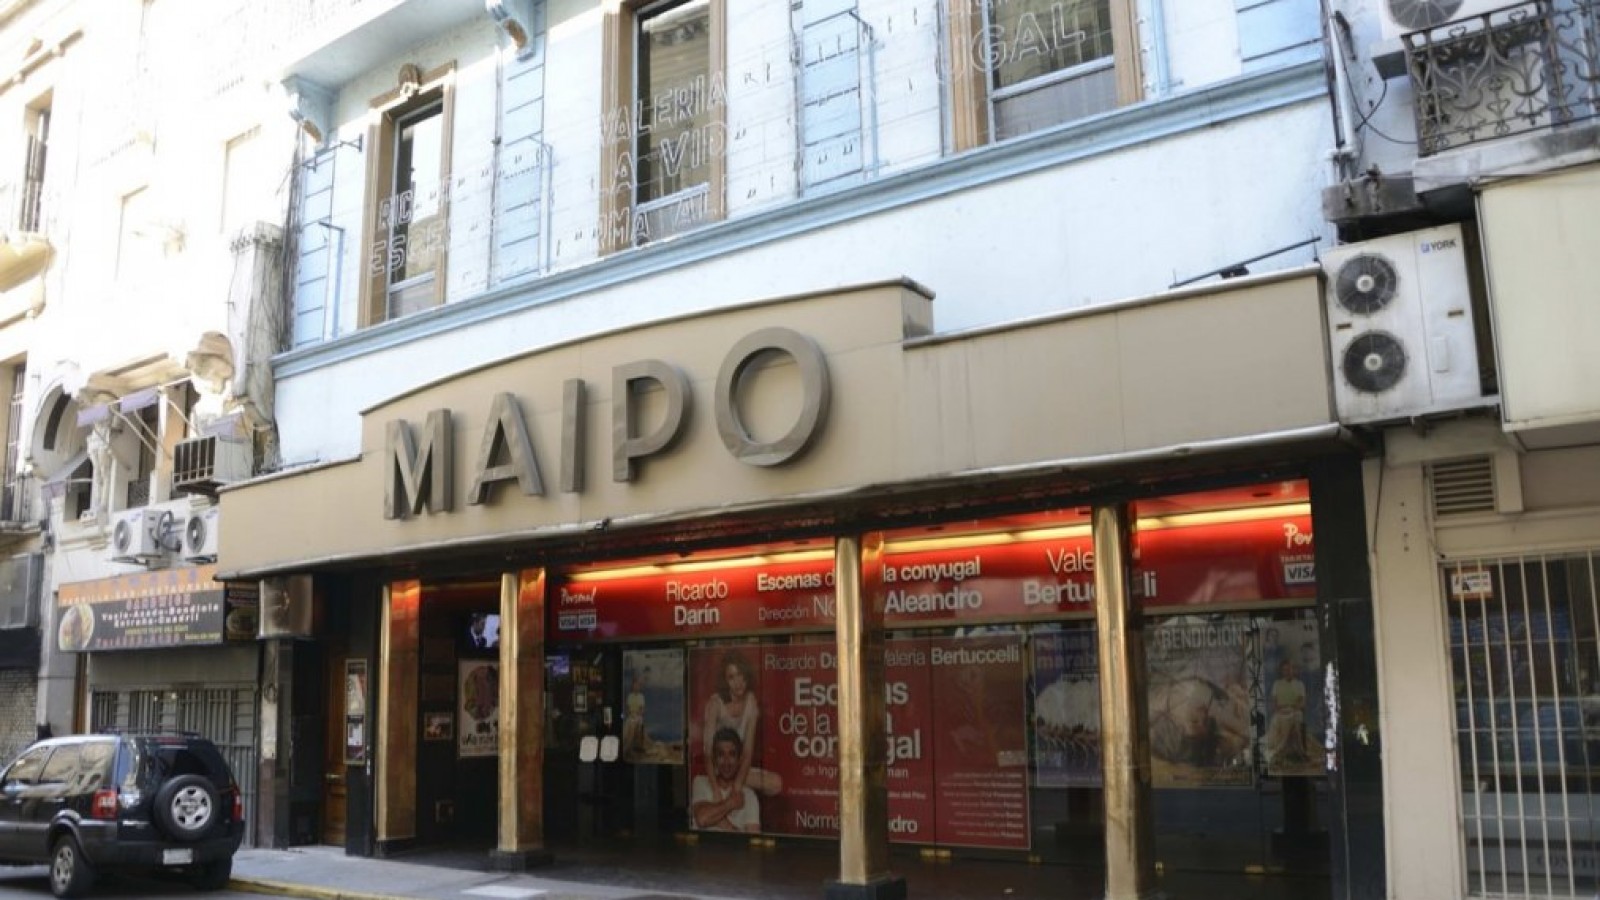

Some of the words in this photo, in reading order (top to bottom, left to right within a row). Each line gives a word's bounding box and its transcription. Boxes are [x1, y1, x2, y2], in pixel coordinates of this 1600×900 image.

[384, 327, 830, 520] MAIPO
[758, 573, 821, 592] Escenas
[900, 555, 980, 582] conyugal
[666, 580, 728, 602] Ricardo
[885, 587, 982, 614] Aleandro
[1023, 571, 1157, 605] Bertuli
[674, 603, 720, 626] Darín
[764, 653, 817, 671] Ricardo
[930, 644, 1019, 665] Bertuccelli
[779, 707, 807, 735] de
[813, 707, 831, 735] la
